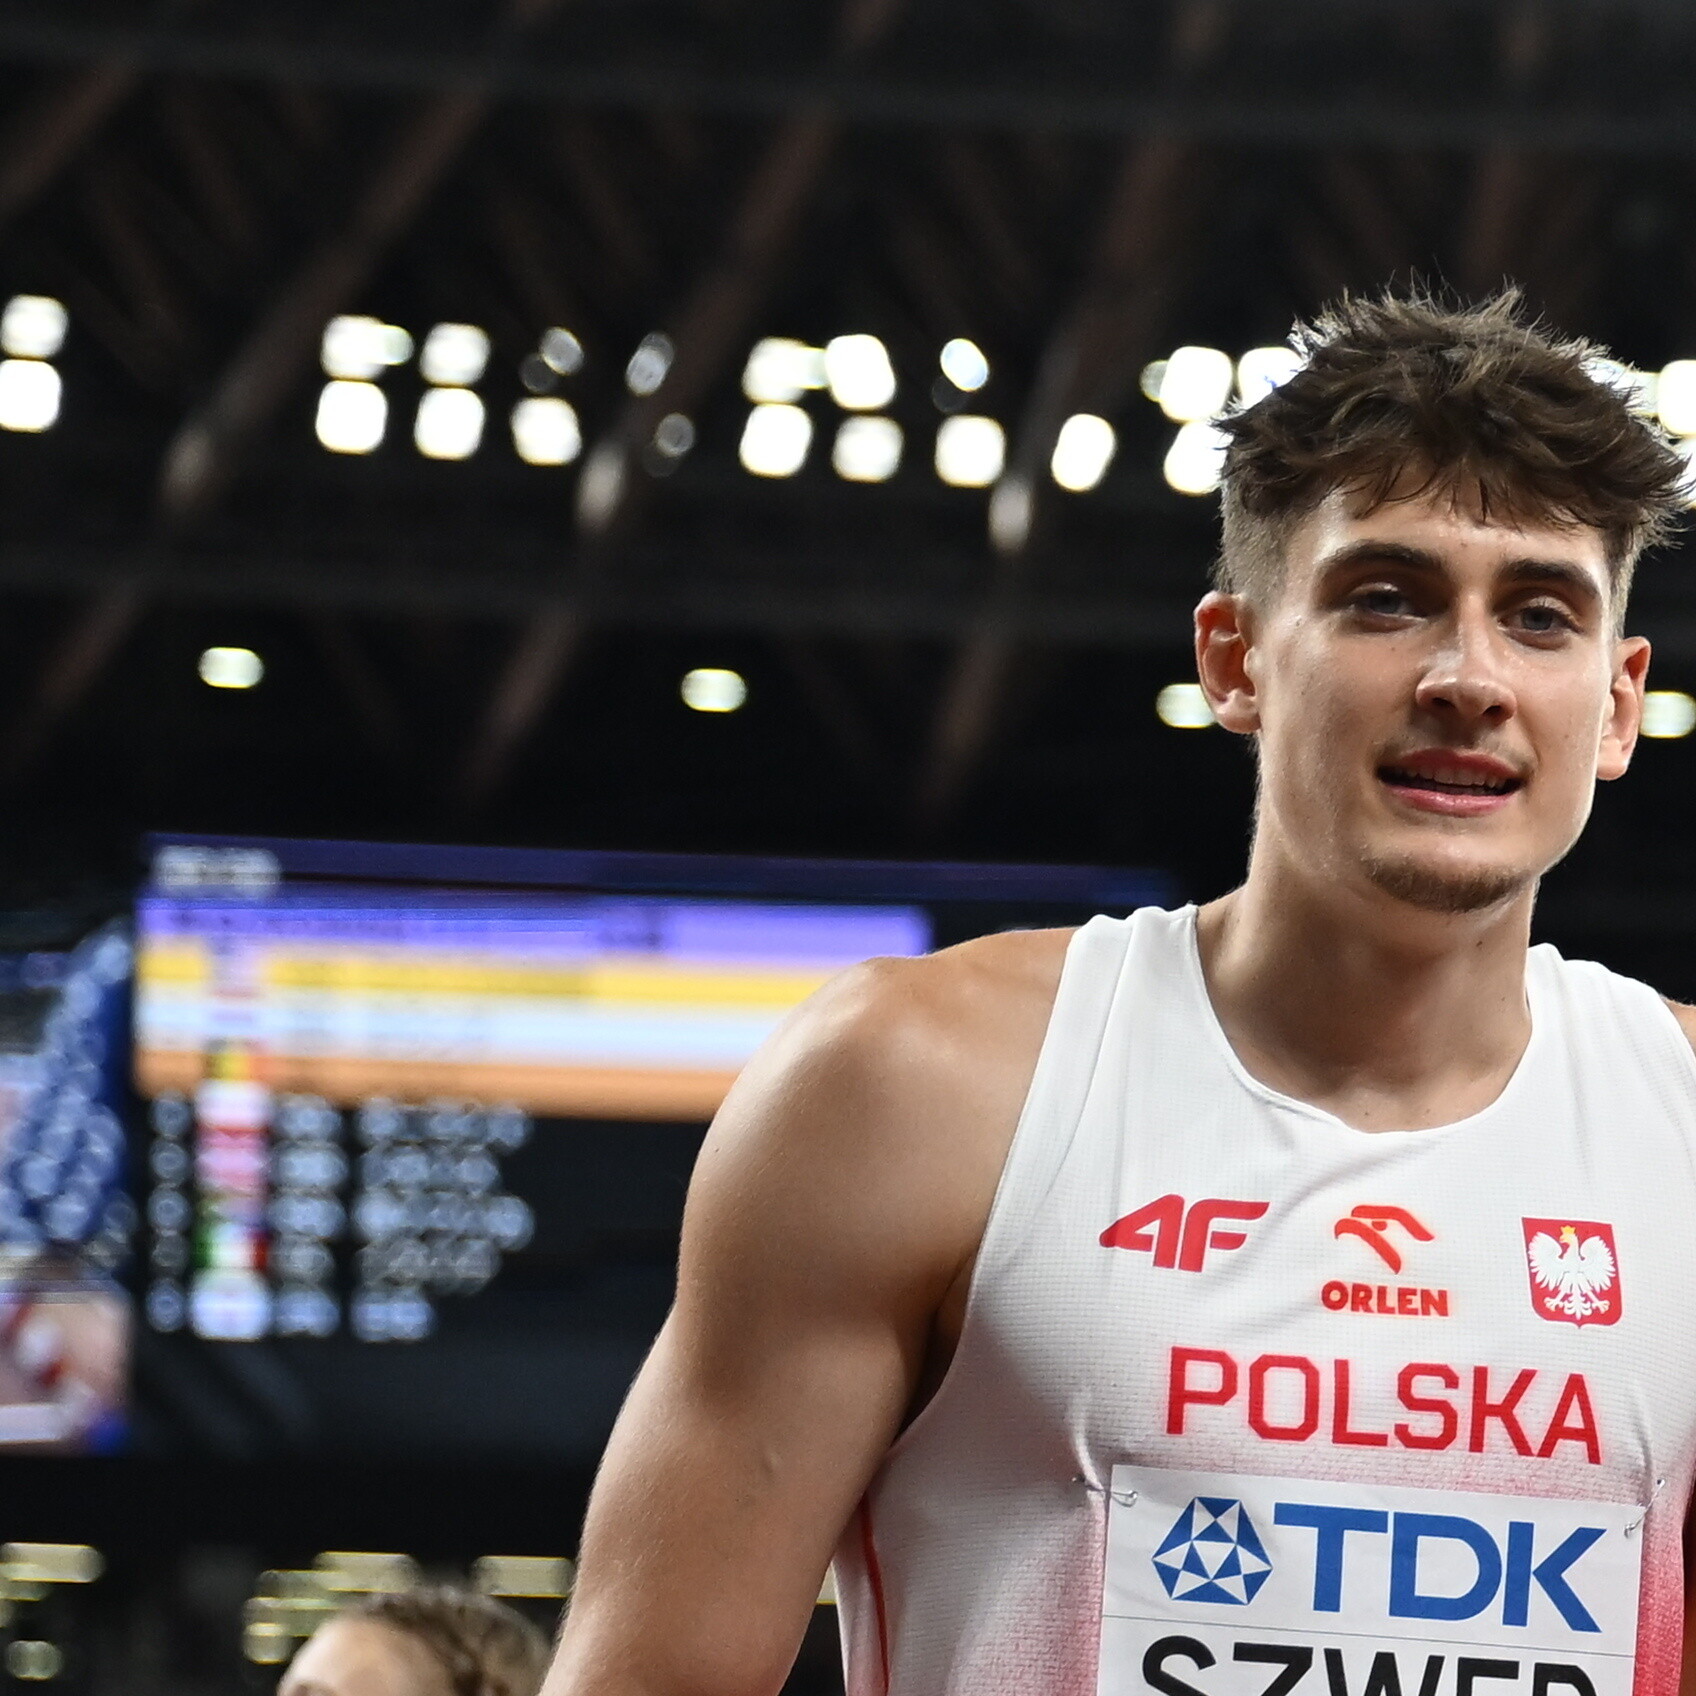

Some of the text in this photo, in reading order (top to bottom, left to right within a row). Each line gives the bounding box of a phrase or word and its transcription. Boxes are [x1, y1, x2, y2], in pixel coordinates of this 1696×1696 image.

[1100, 1194, 1269, 1272] 4F
[1321, 1280, 1449, 1317] ORLEN
[1166, 1346, 1601, 1464] POLSKA
[1274, 1502, 1607, 1633] TDK
